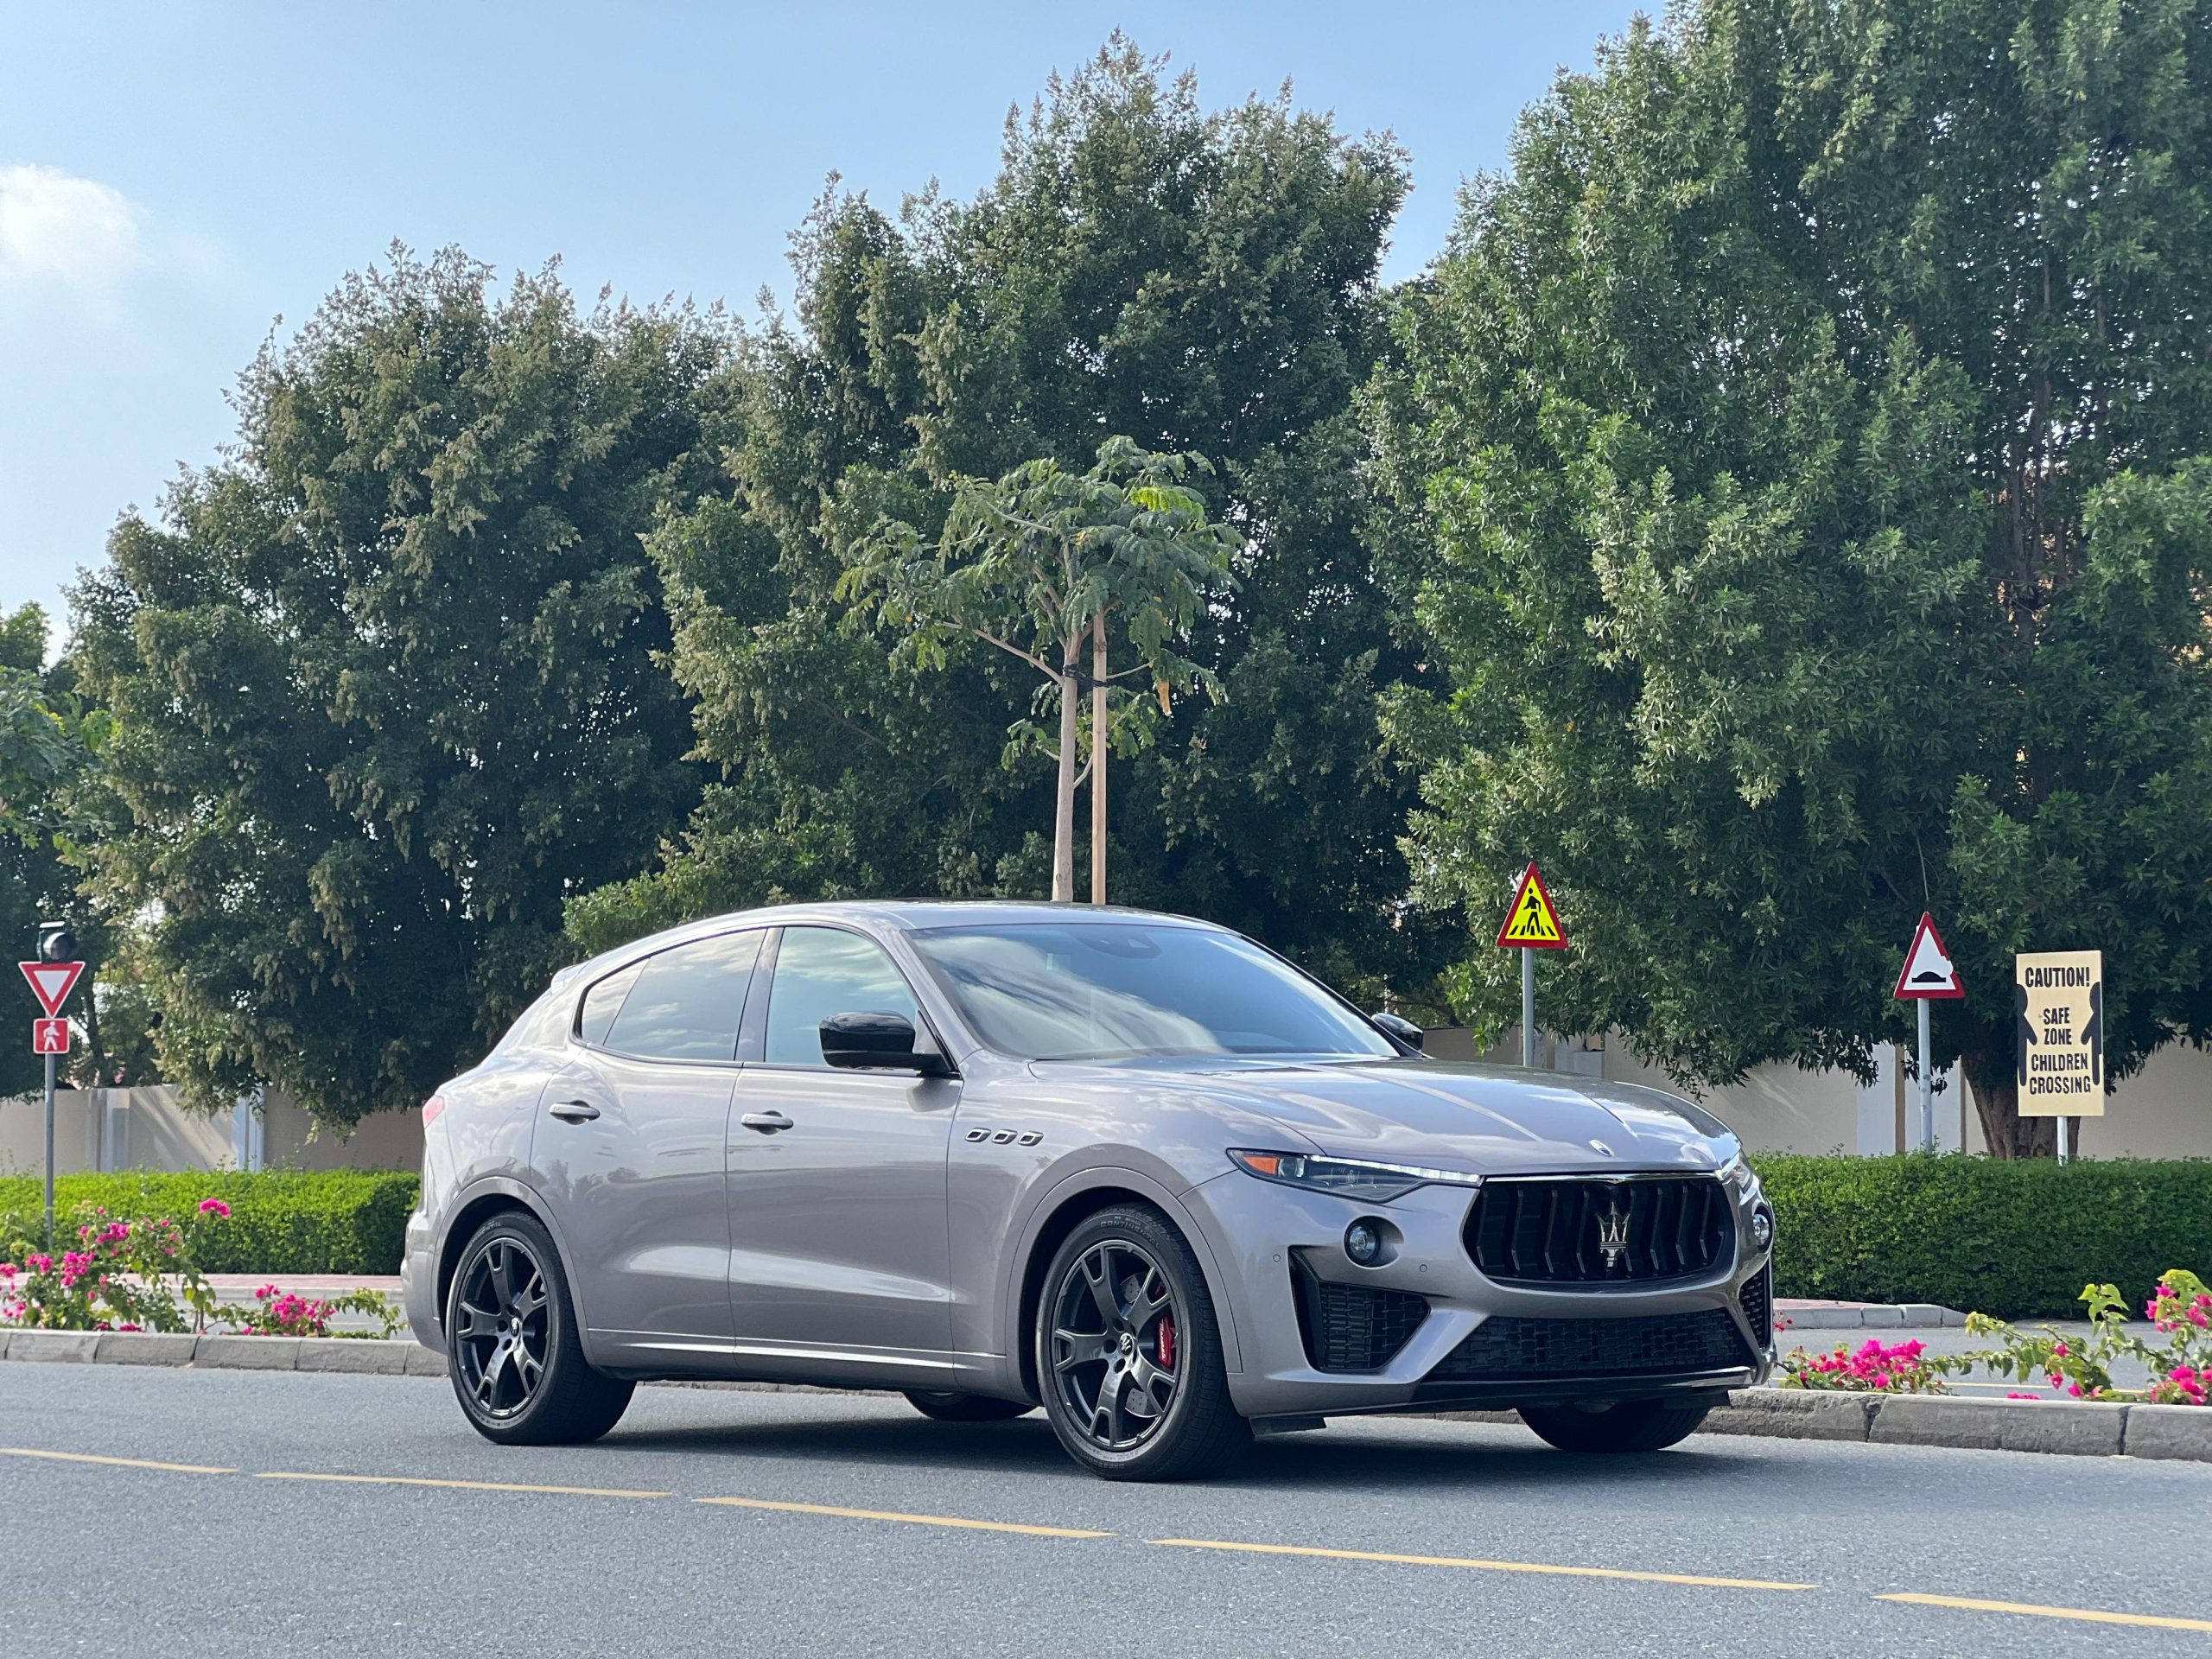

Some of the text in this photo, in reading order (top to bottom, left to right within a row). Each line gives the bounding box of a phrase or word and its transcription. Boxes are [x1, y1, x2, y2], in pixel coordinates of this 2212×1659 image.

[2024, 967, 2090, 988] CAUTION!
[2043, 1007, 2070, 1025] SAFE
[2044, 1028, 2072, 1046] ZONE
[2031, 1053, 2088, 1071] CHILDREN
[2030, 1076, 2091, 1095] CROSSING
